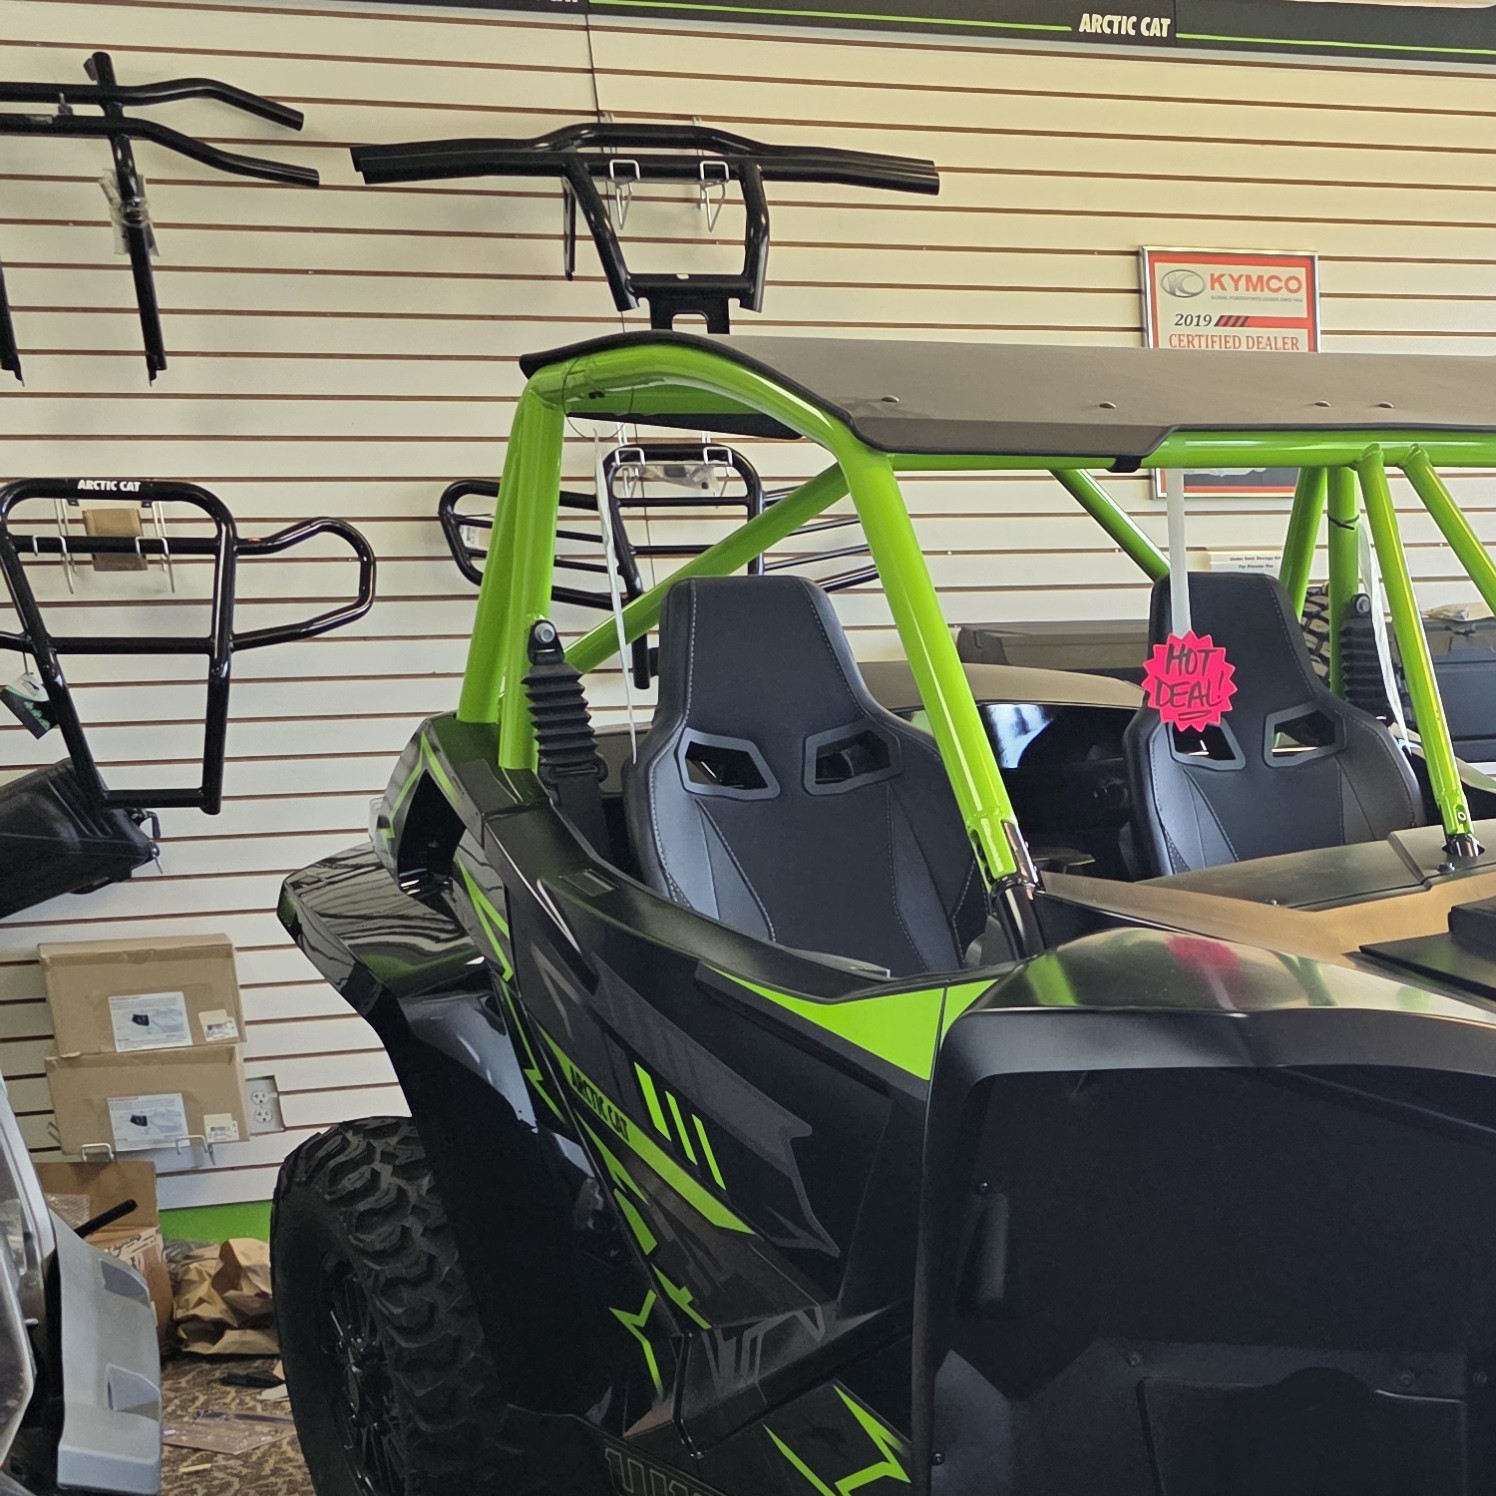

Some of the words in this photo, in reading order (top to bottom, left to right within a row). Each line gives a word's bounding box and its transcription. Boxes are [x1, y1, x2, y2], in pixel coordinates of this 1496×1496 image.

[1079, 13, 1137, 35] ARCTIC
[1140, 17, 1171, 37] CAT
[1209, 272, 1303, 294] KYMCO
[1174, 313, 1212, 327] 2019
[1168, 333, 1242, 351] CERTIFIED
[1245, 335, 1300, 351] DEALER
[77, 479, 118, 491] ARCTIC
[119, 481, 141, 492] CAT
[1165, 643, 1218, 677] HOT
[1153, 670, 1225, 709] DEAL!
[569, 1065, 609, 1121] ARCTIC
[607, 1105, 630, 1142] CAT
